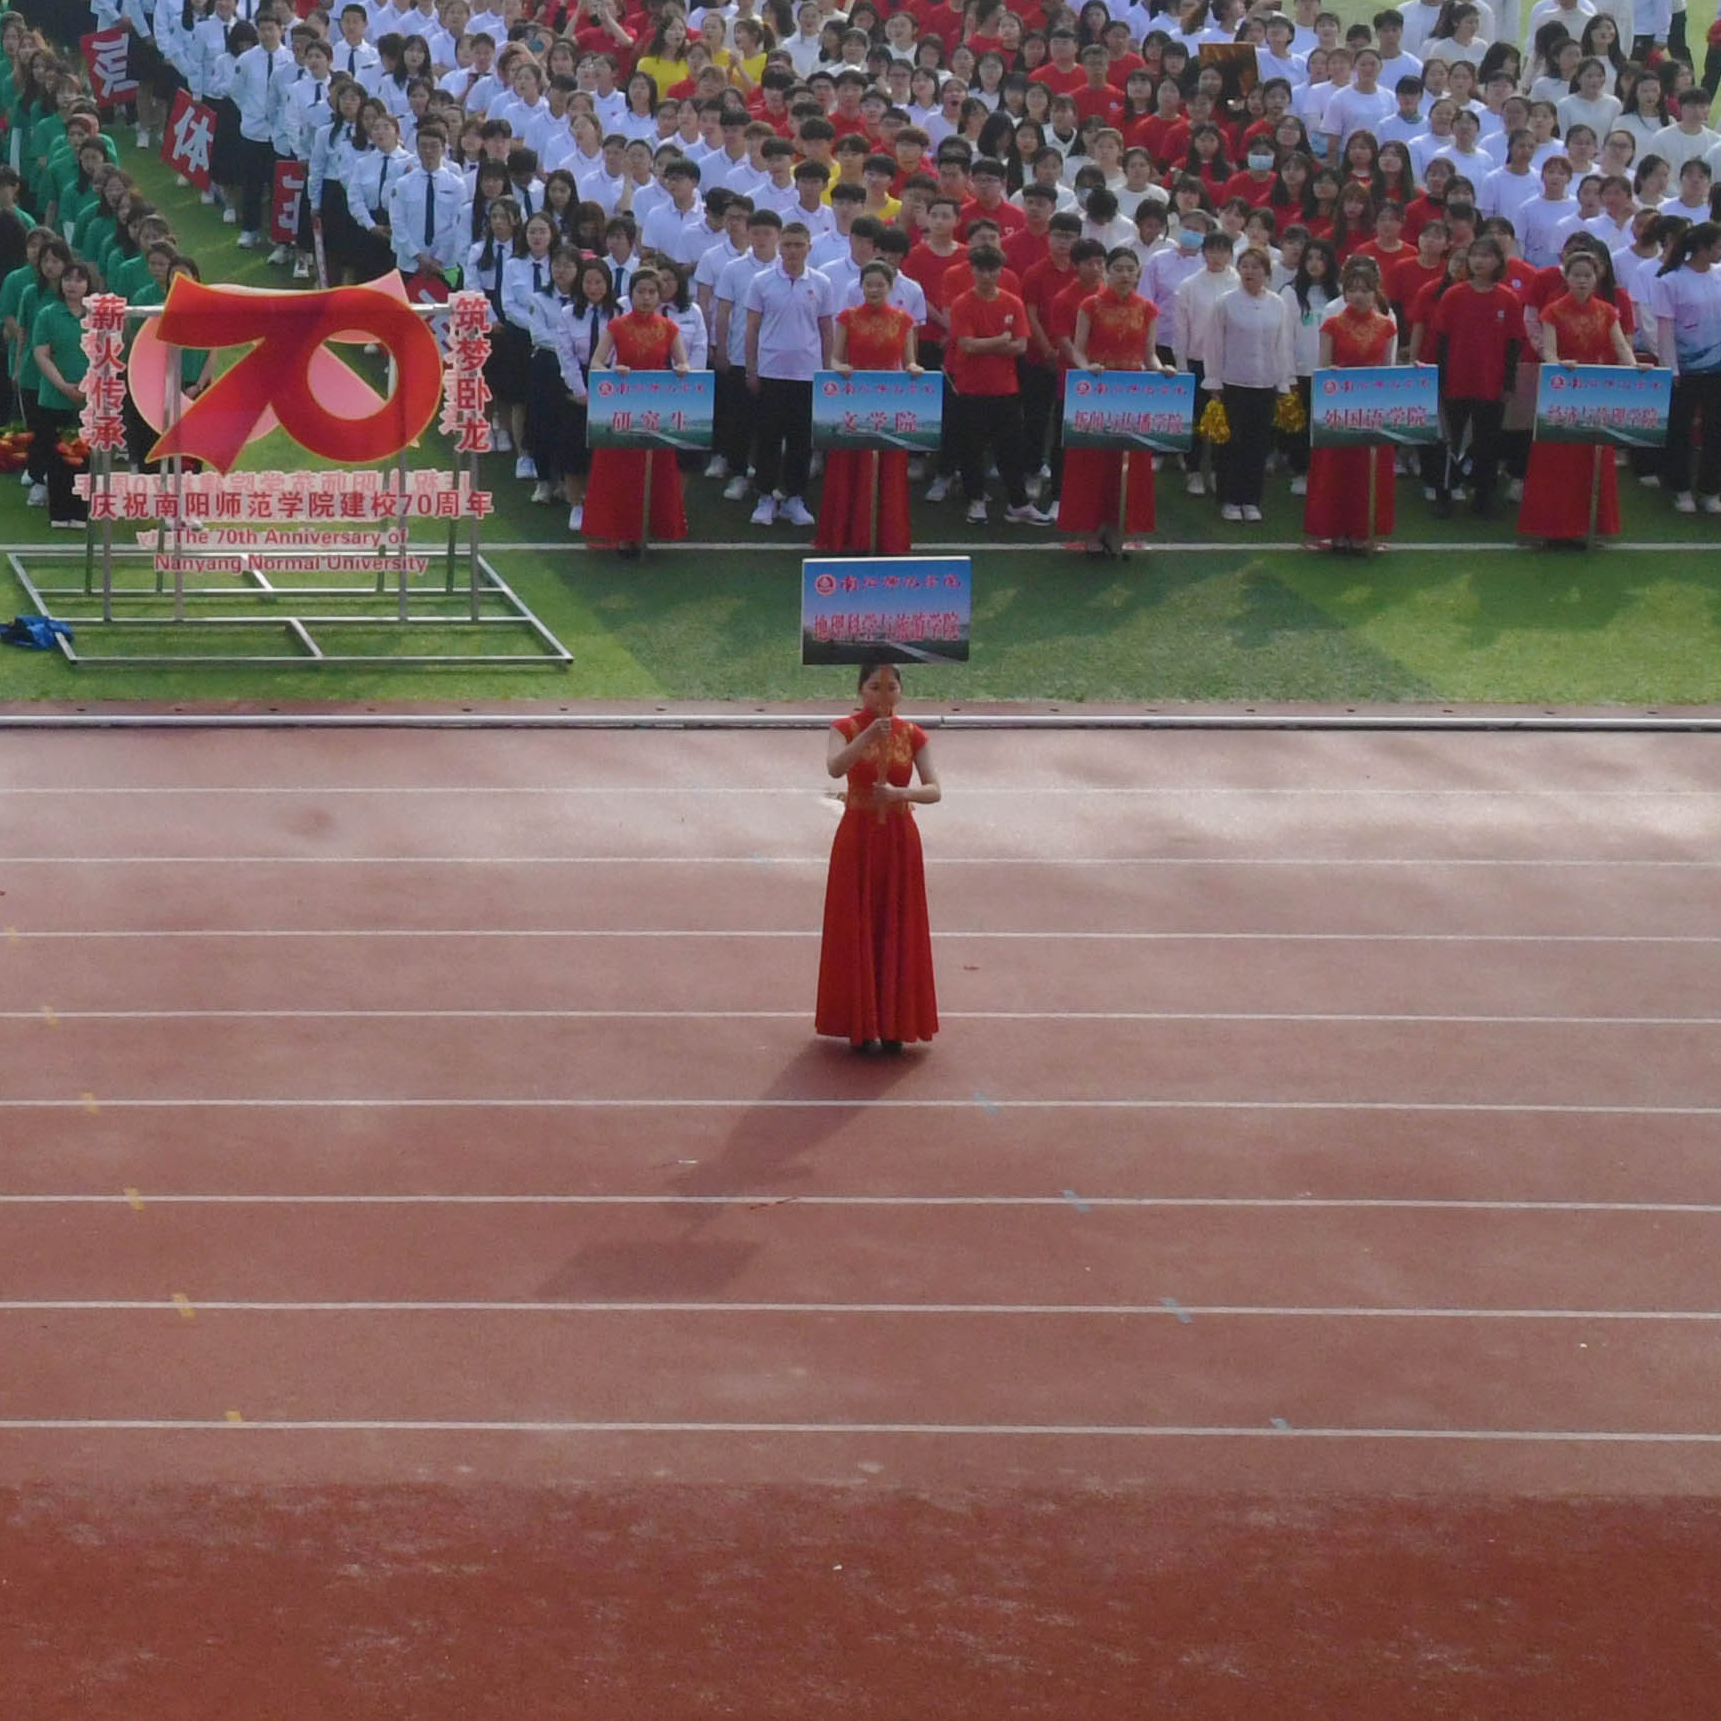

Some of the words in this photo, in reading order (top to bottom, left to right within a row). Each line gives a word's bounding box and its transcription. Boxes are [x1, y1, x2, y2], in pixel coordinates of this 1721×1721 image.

[172, 104, 214, 174] 体
[91, 296, 126, 451] 薪火传承
[456, 297, 492, 453] 筑梦卧龙
[612, 410, 687, 432] 研究生
[843, 410, 918, 433] 文学院
[1325, 405, 1427, 430] 外国语学院
[91, 491, 493, 520] 庆祝南阳师范学院建校70周年
[175, 528, 209, 545] The
[217, 528, 257, 545] 70th
[264, 527, 381, 548] Anniversary
[388, 528, 407, 545] of
[155, 555, 242, 574] Nanyang
[248, 554, 320, 571] Normal
[327, 555, 428, 575] University
